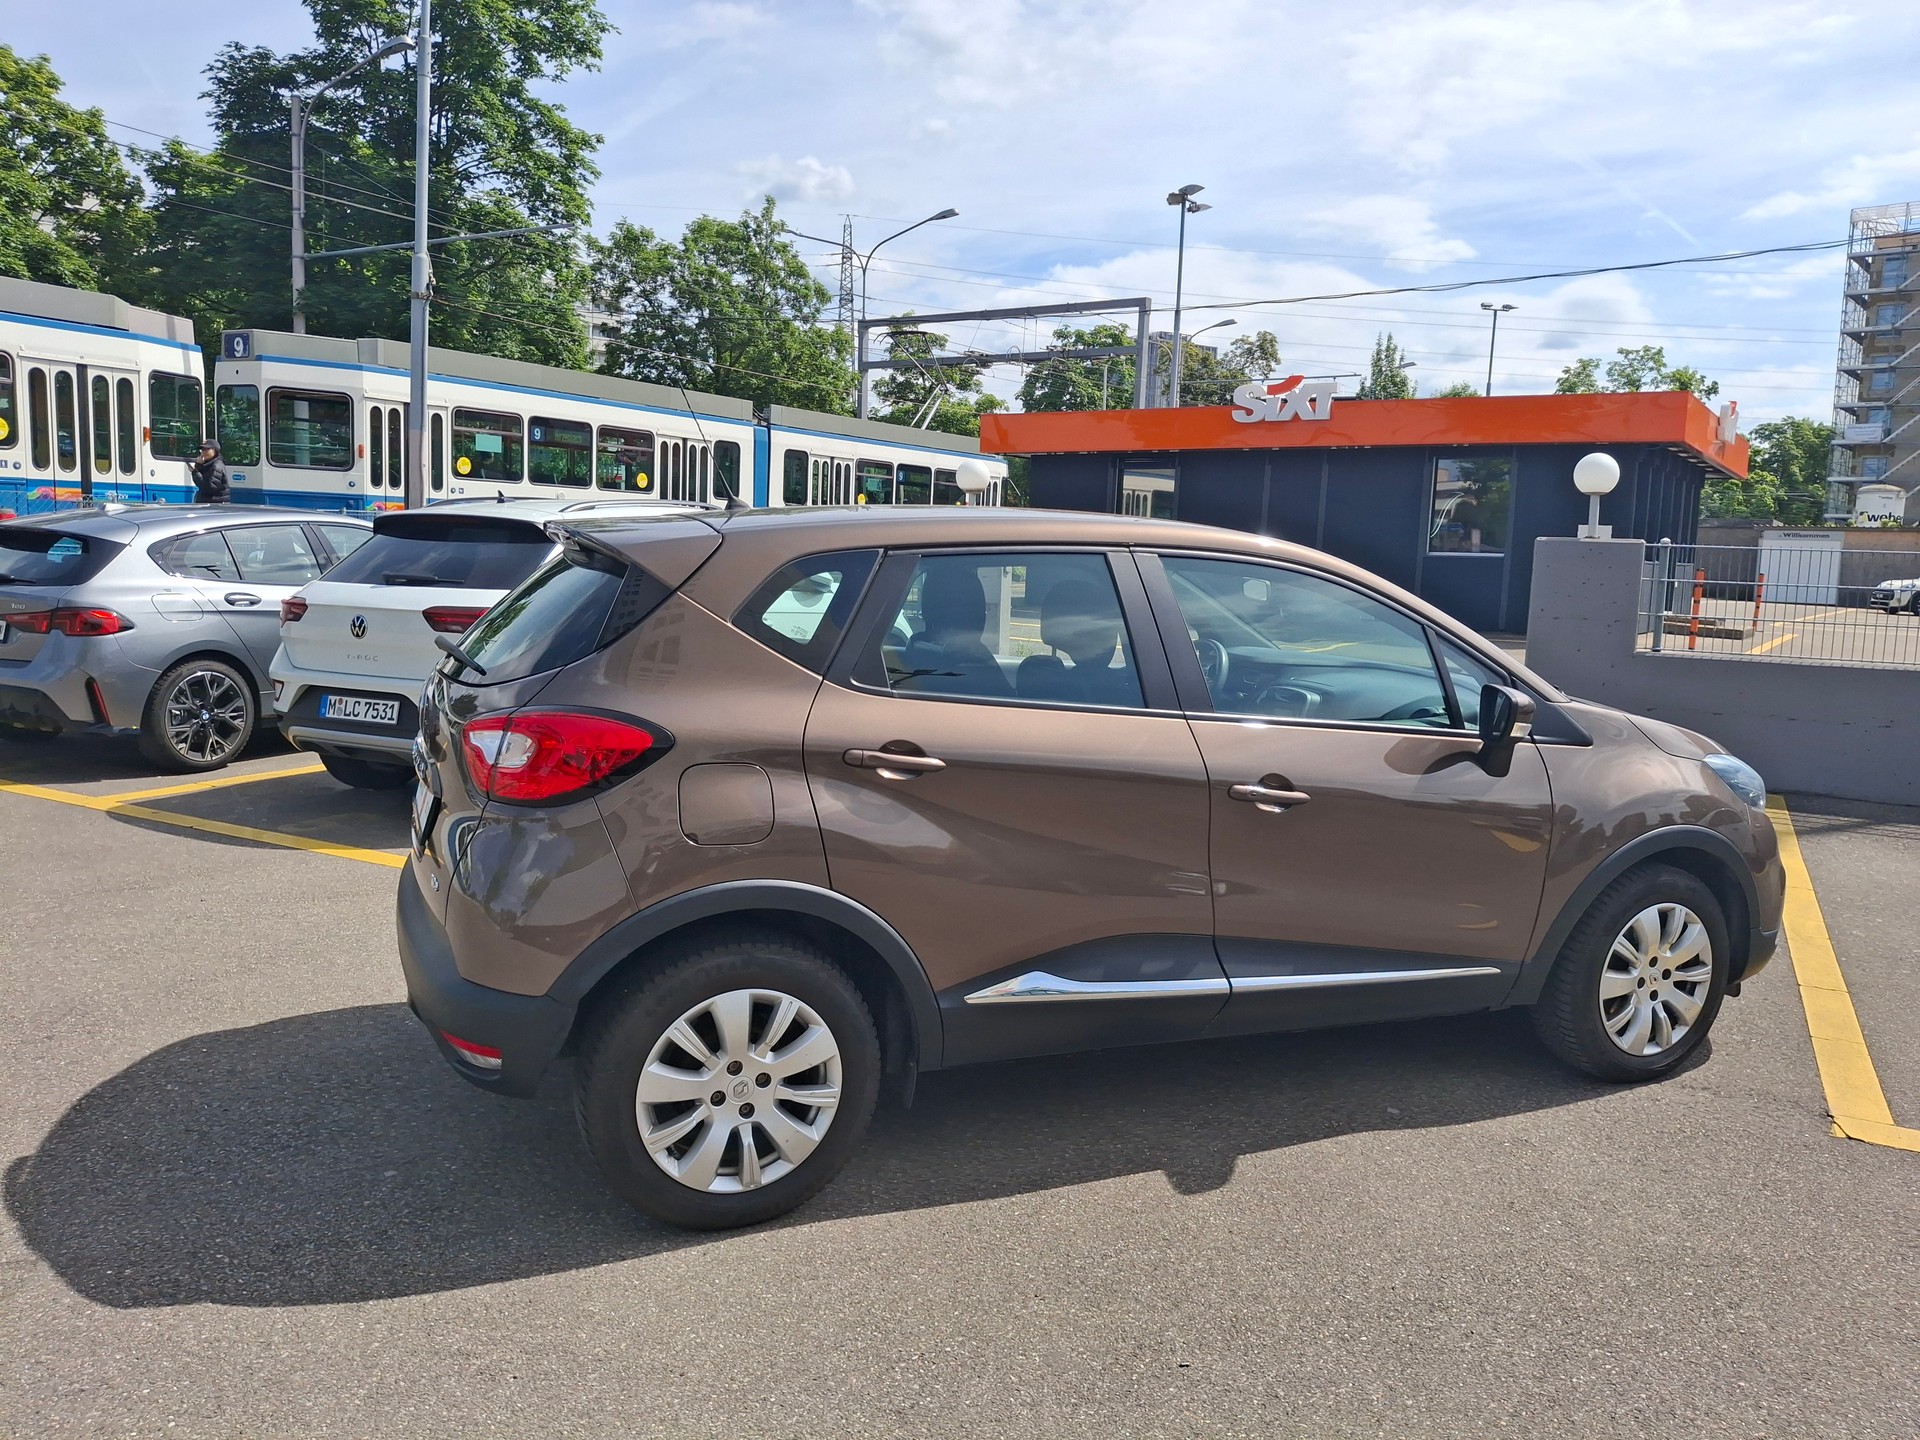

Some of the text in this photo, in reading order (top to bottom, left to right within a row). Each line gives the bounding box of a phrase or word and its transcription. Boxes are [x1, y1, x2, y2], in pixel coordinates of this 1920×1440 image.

[234, 337, 243, 357] 9
[534, 427, 541, 440] 9
[899, 472, 903, 481] 9
[327, 698, 395, 721] M LC 7531
